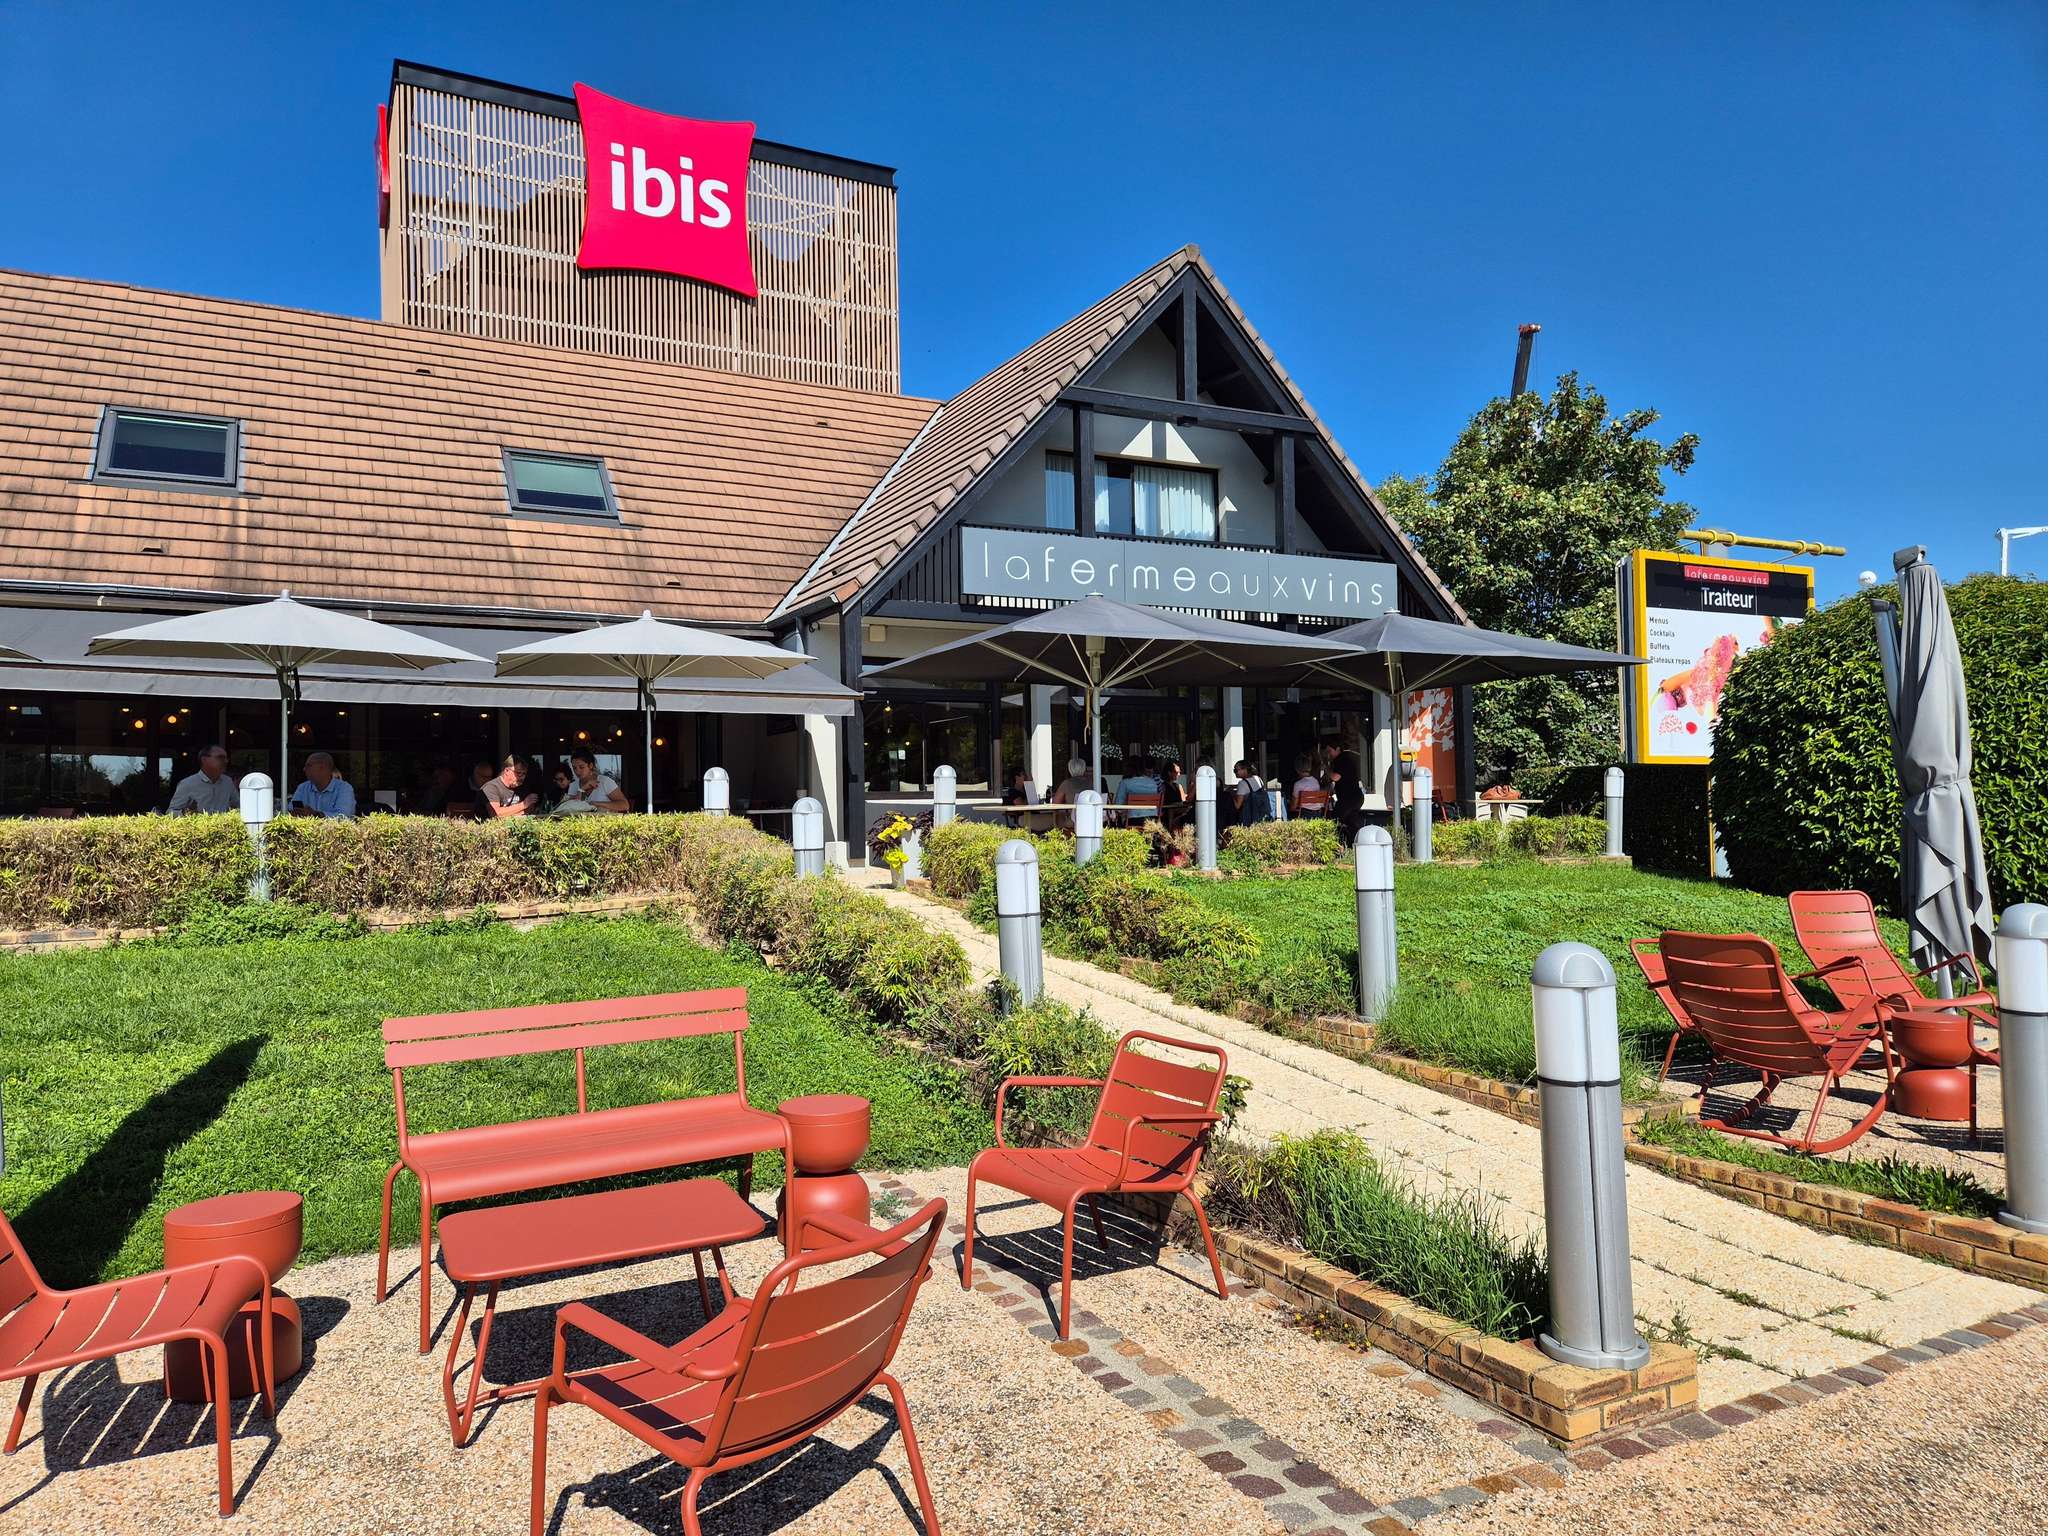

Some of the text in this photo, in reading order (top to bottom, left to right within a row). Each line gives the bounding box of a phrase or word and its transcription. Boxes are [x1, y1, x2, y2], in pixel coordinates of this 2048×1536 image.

[610, 142, 732, 228] ibis
[1701, 587, 1754, 608] Traiteur
[1649, 616, 1669, 625] Menus
[1649, 628, 1675, 637] Cocktails
[1649, 642, 1670, 650] Buffets
[1650, 655, 1674, 664] Plateaux
